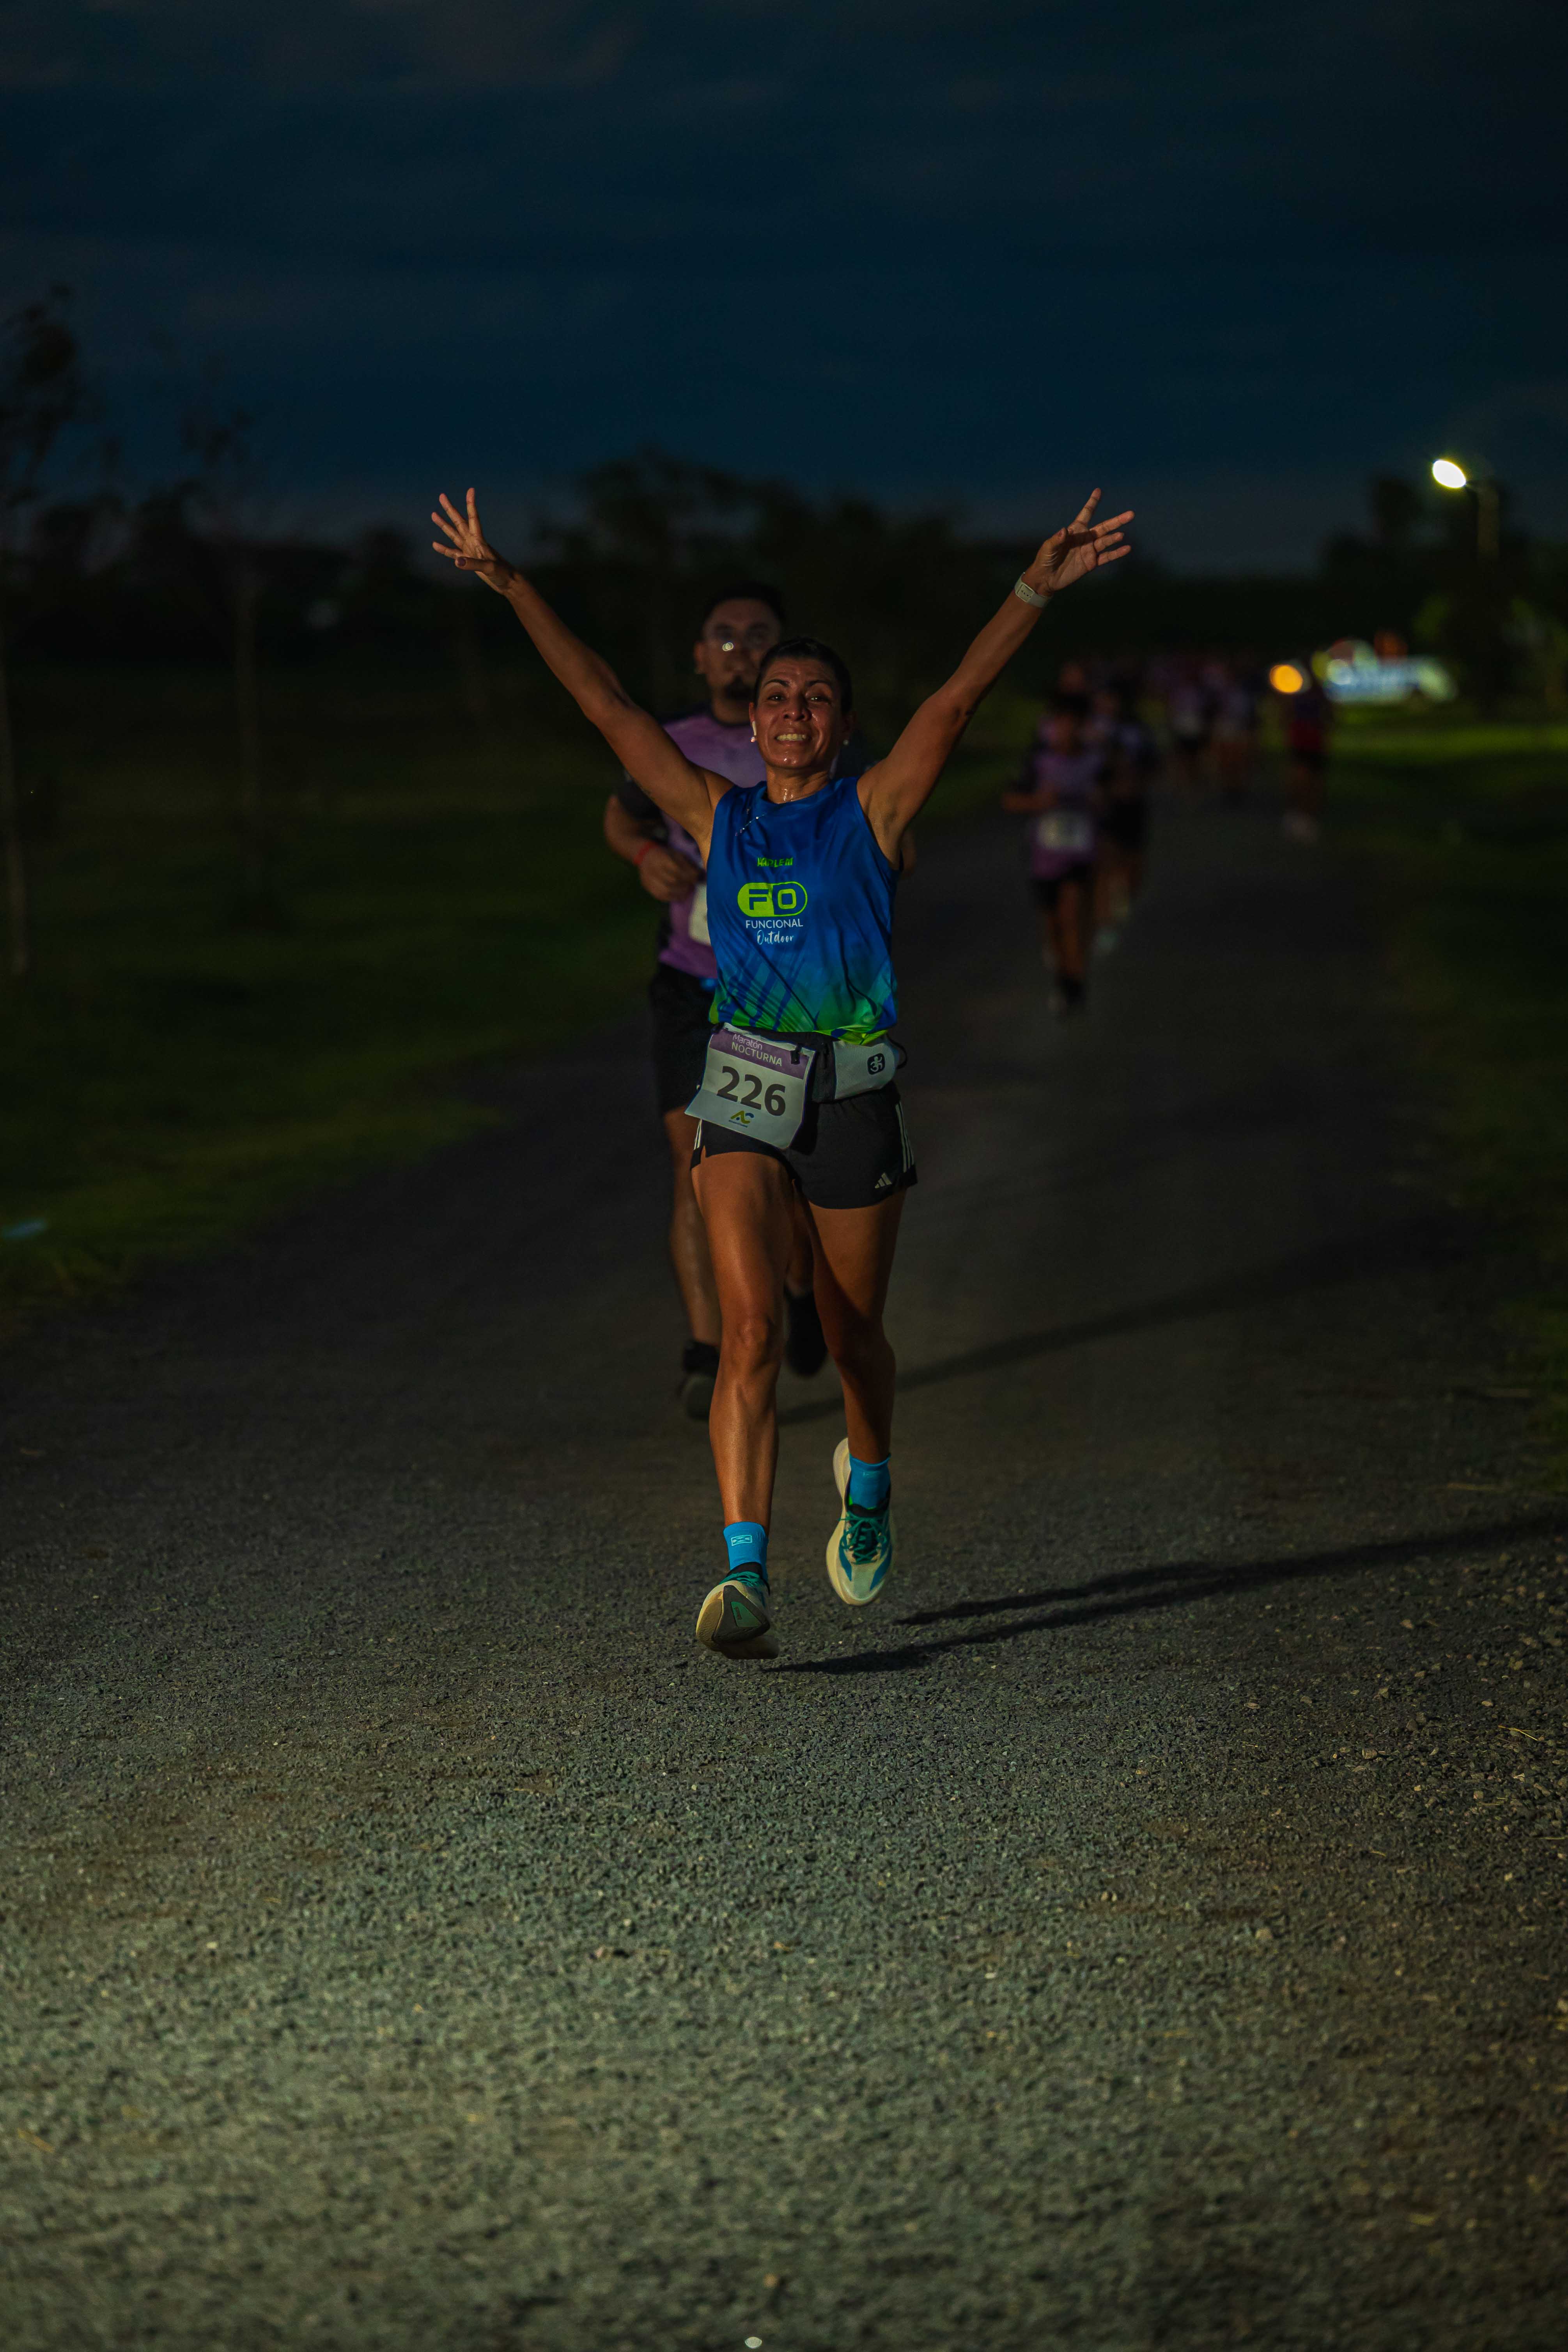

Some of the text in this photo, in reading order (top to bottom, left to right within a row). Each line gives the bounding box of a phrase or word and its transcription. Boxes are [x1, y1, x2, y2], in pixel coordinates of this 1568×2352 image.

[745, 918, 804, 929] FUNCIONAL
[757, 930, 794, 945] Outdoor
[732, 1033, 763, 1050] Maratón
[731, 1041, 783, 1067] NOCTURNA
[716, 1066, 786, 1116] 226
